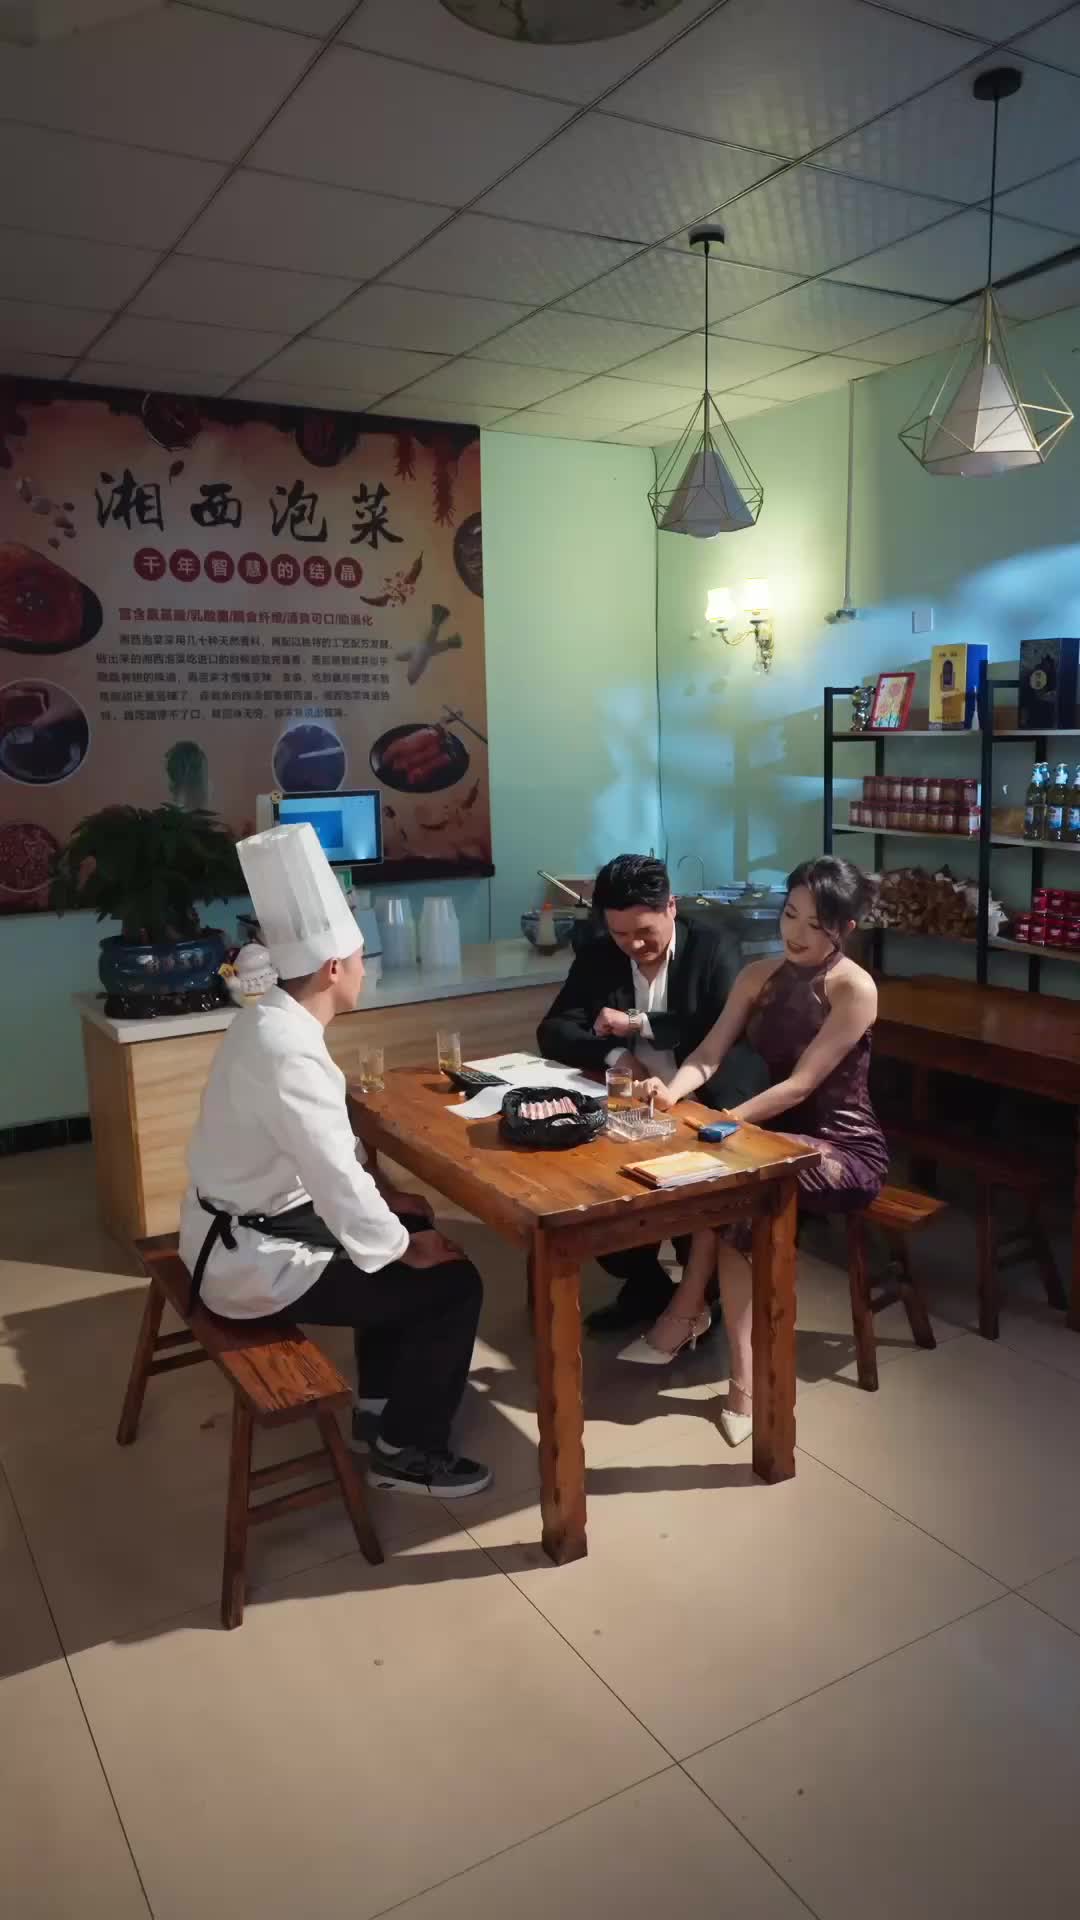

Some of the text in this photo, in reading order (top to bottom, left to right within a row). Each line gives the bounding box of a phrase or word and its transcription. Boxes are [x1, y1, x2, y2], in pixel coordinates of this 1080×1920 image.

[95, 469, 404, 549] 湘西泡菜
[141, 552, 358, 584] 千年智慧的结晶
